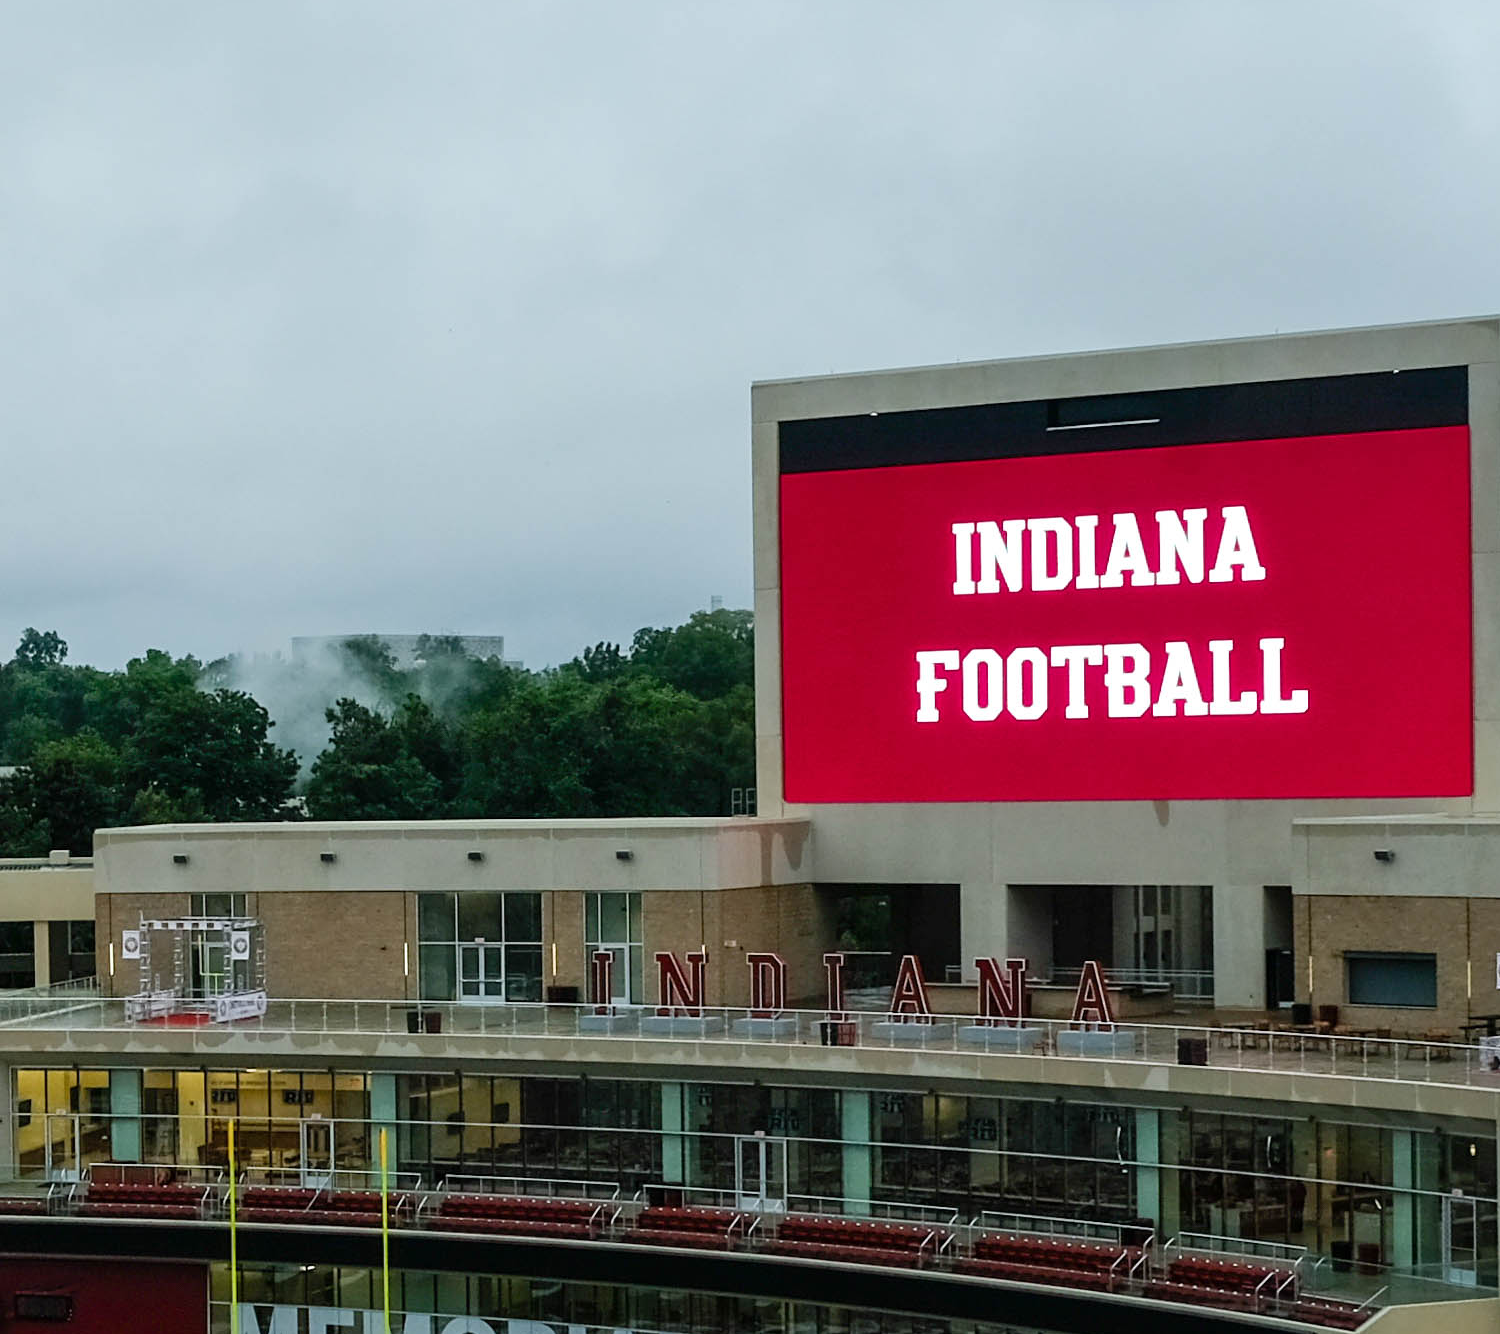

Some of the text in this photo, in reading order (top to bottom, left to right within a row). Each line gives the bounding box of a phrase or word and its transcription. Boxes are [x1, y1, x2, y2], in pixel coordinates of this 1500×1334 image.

[952, 506, 1266, 595] INDIANA
[916, 637, 1309, 723] FOOTBALL
[591, 950, 1118, 1033] INDIANA
